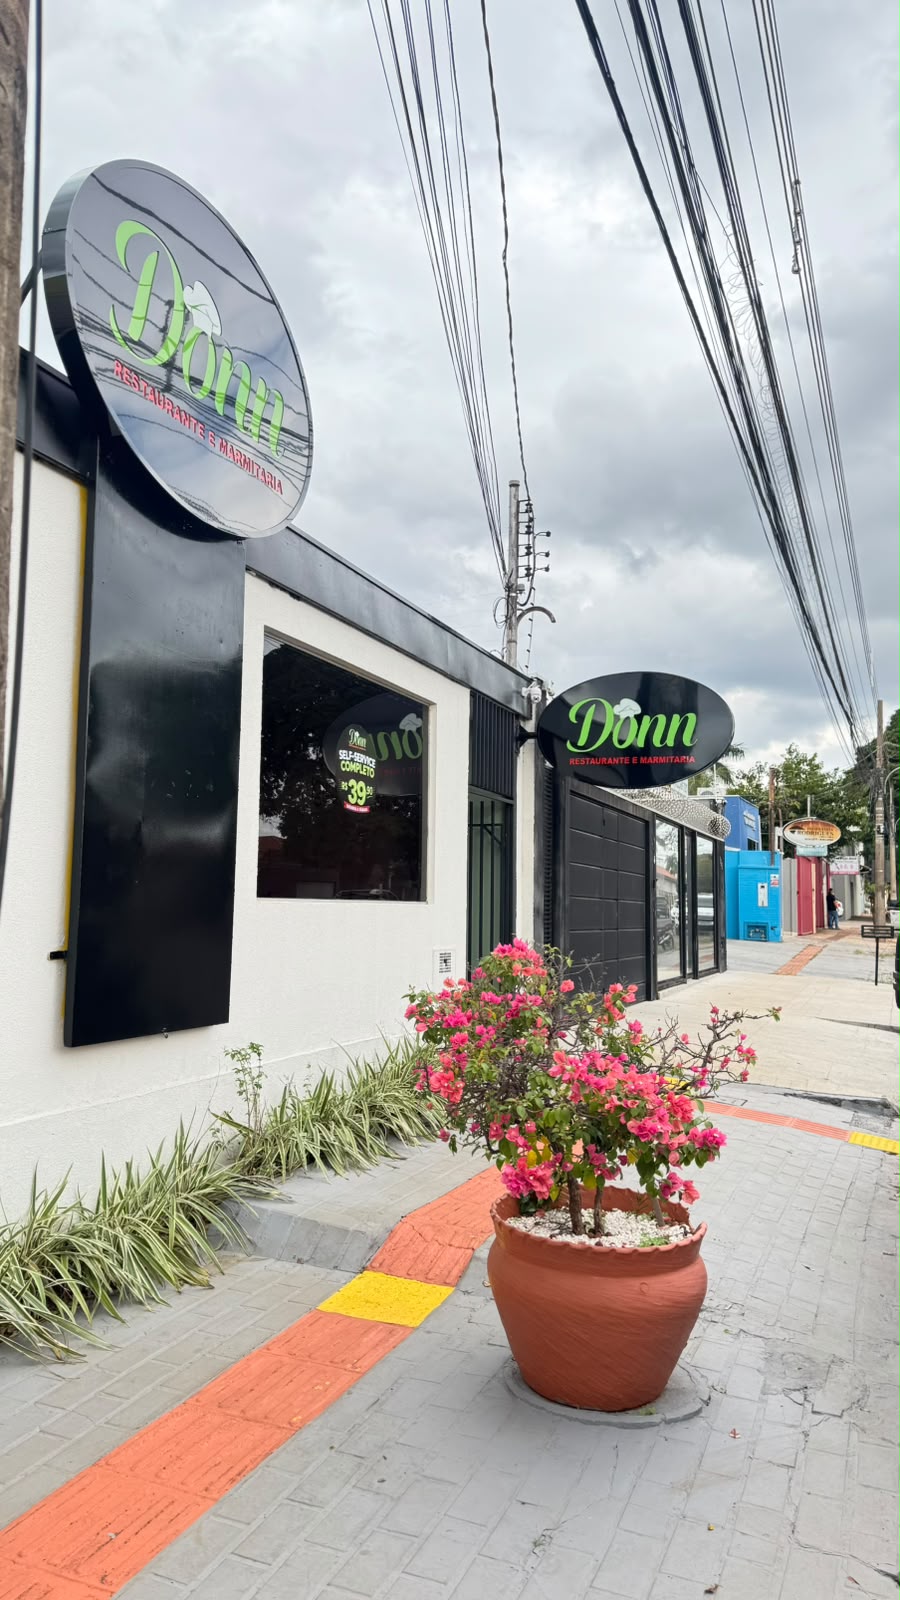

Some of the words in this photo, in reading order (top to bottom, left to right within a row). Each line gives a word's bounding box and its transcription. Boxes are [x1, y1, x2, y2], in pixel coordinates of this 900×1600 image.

[109, 219, 285, 458] Donn
[114, 359, 206, 440] RESTAURANTE
[208, 431, 216, 448] E
[219, 437, 283, 495] MARMITARIA
[566, 698, 699, 753] Donn
[339, 749, 376, 768] SELF-SERVICE
[340, 760, 375, 778] COMPLETO
[569, 756, 630, 766] RESTAURANTE
[632, 756, 638, 764] E
[640, 755, 696, 764] MARMITARIA
